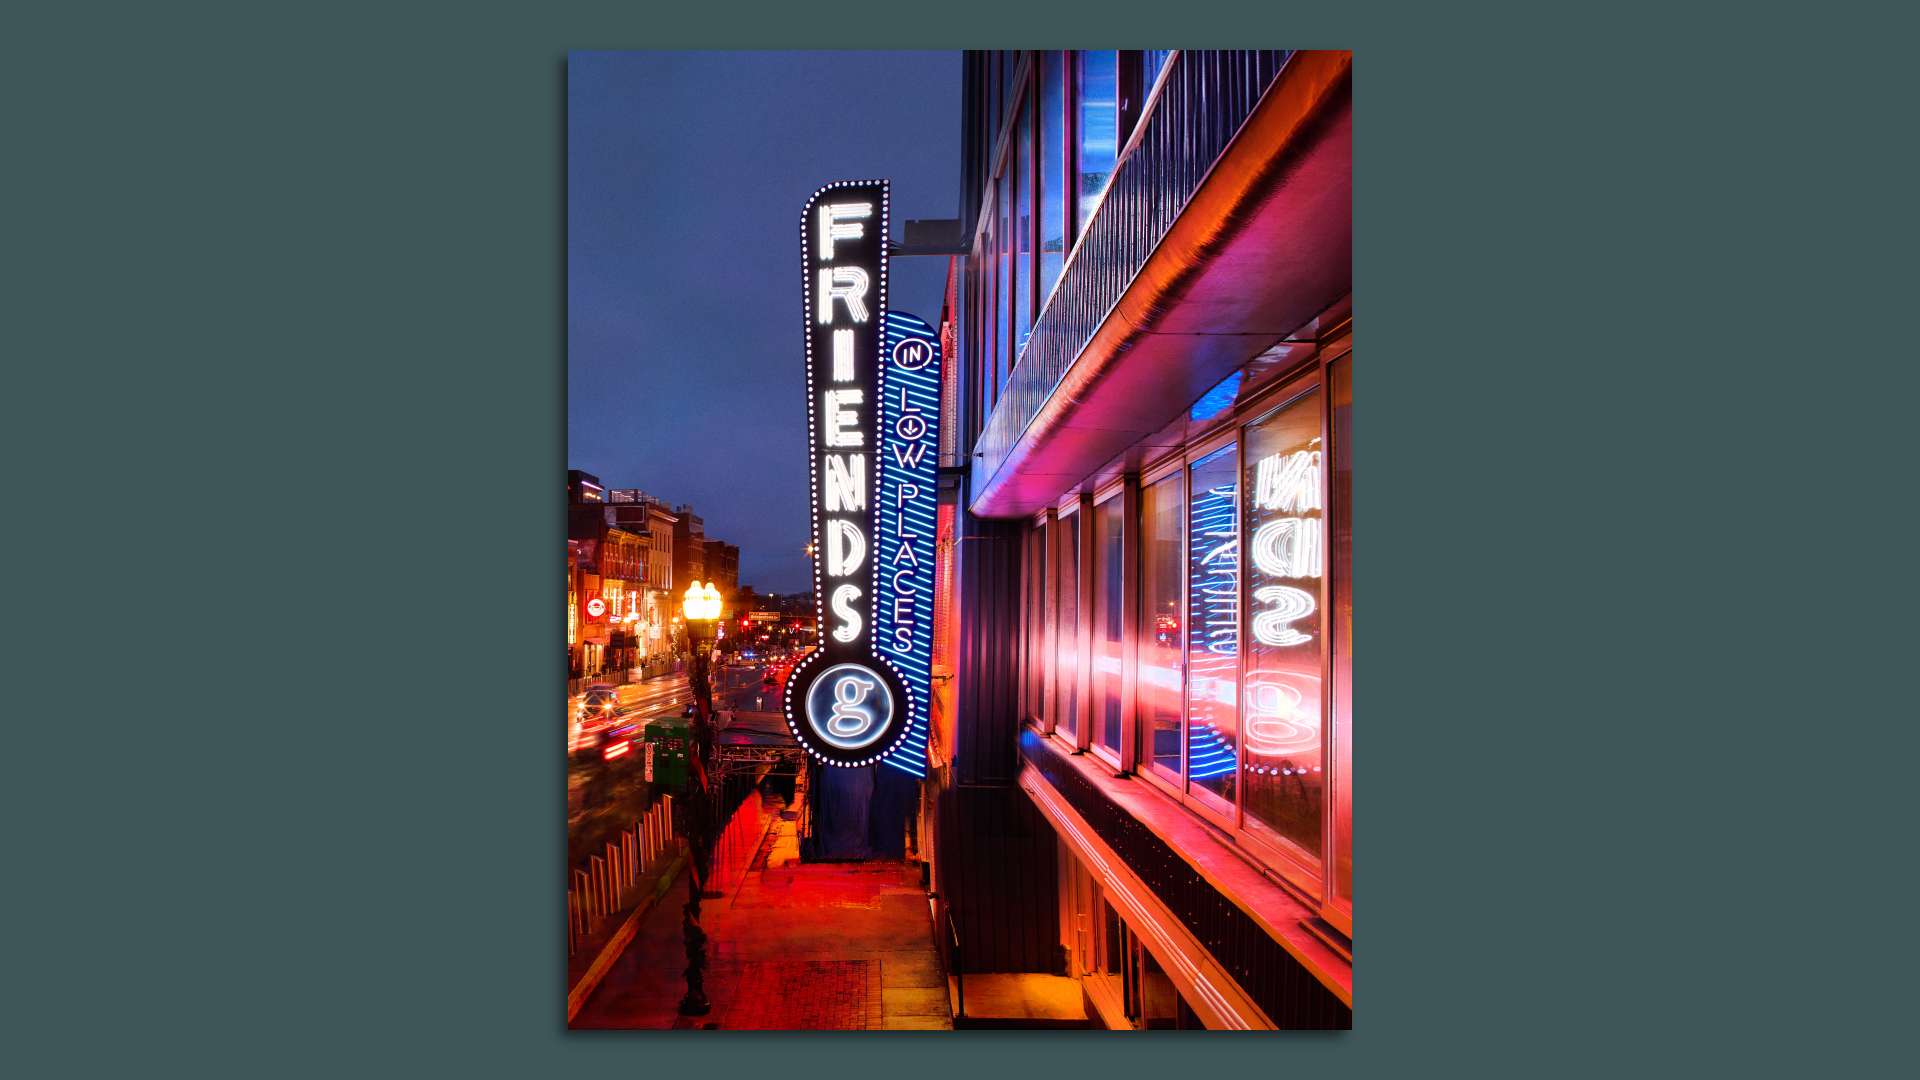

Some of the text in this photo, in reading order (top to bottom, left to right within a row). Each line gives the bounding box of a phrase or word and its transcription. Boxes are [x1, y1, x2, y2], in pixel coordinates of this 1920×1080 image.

[903, 344, 922, 365] IN
[819, 204, 873, 643] FRIENDS
[892, 387, 926, 468] LOW
[892, 483, 919, 653] PLACES
[826, 675, 875, 737] g
